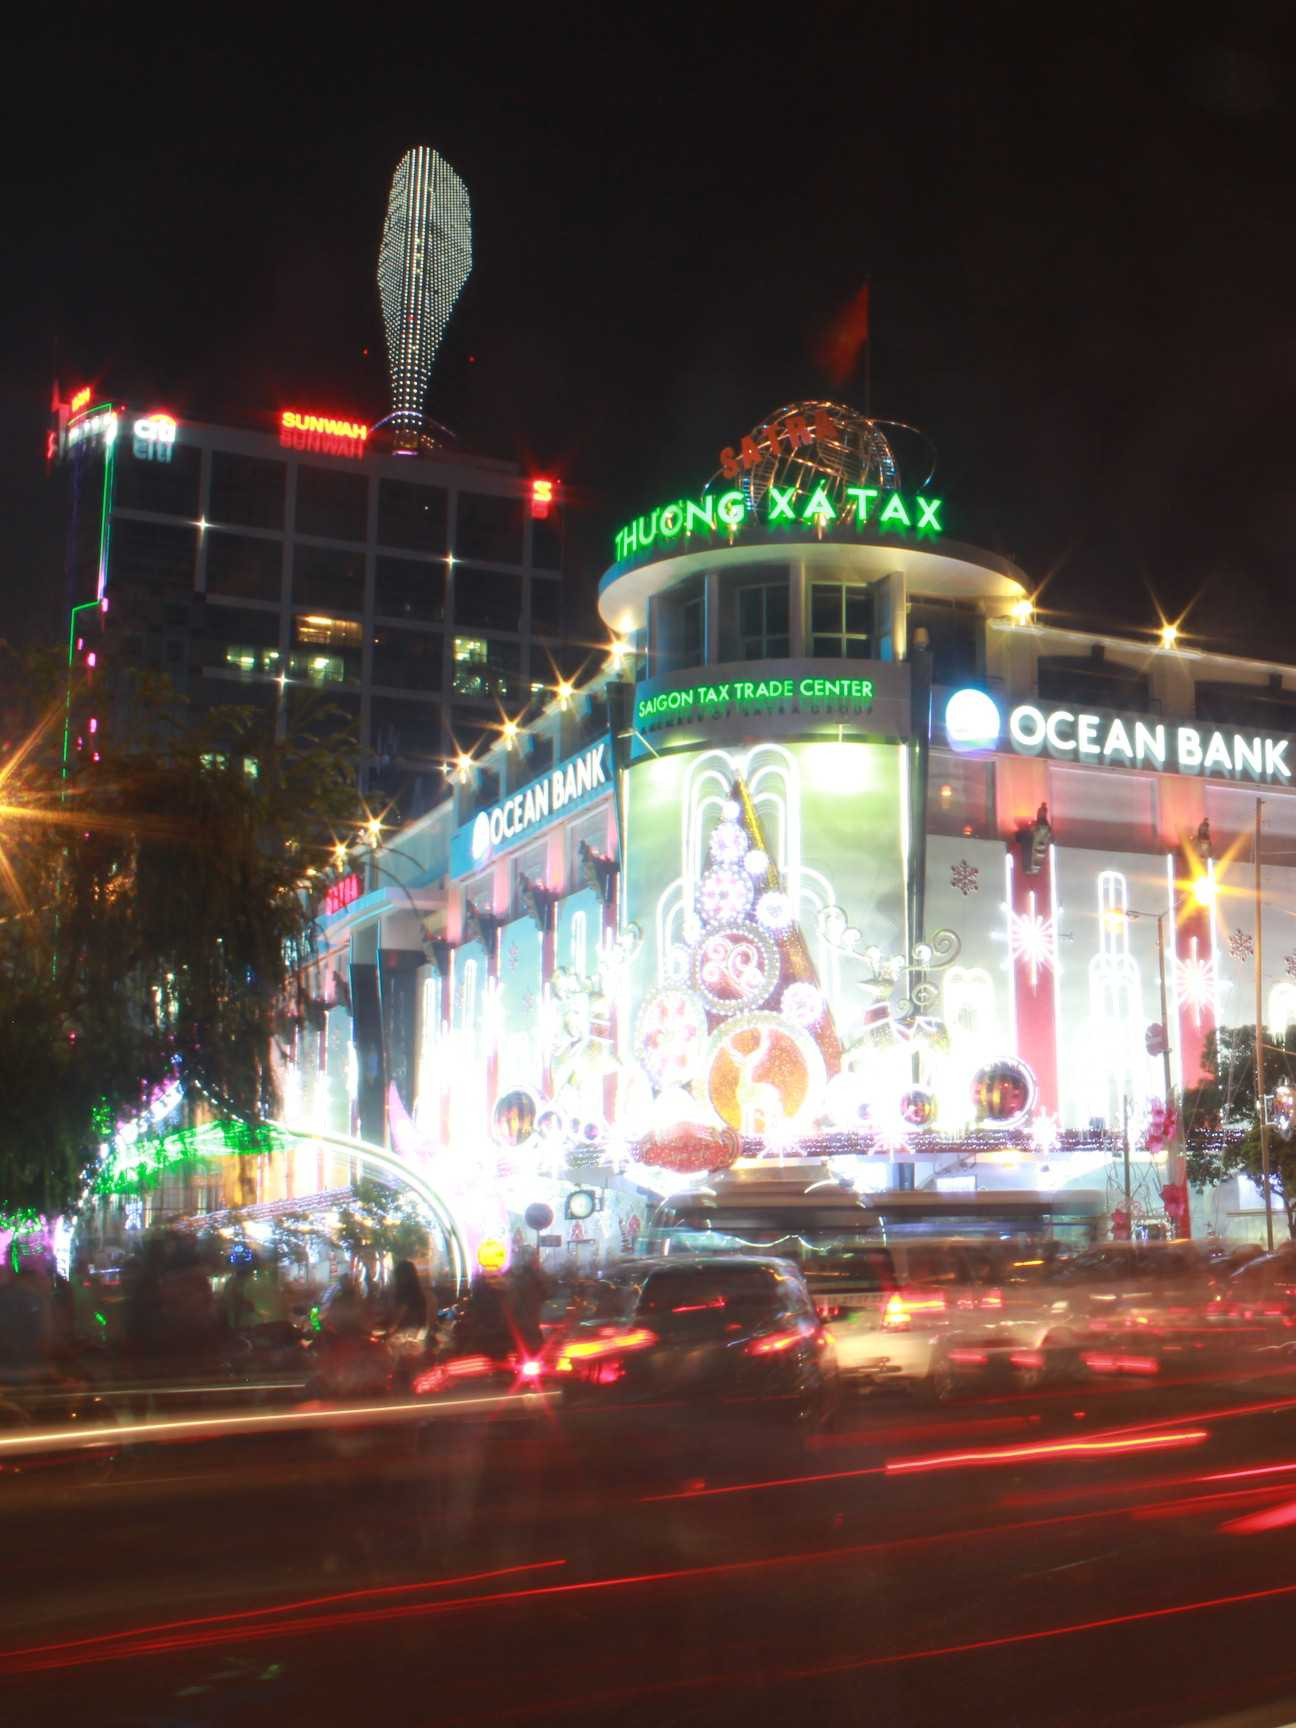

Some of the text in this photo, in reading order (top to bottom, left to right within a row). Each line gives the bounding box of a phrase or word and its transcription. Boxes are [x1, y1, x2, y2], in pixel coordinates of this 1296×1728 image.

[282, 411, 367, 440] SUNWAH
[720, 411, 838, 479] SATRA
[768, 479, 836, 520] XÁ
[848, 488, 943, 532] TAX
[639, 679, 873, 718] SAIGON TAX TRADE CENTER
[1009, 704, 1292, 777] OCEAN BANK
[490, 743, 605, 845] OCEAN BANK
